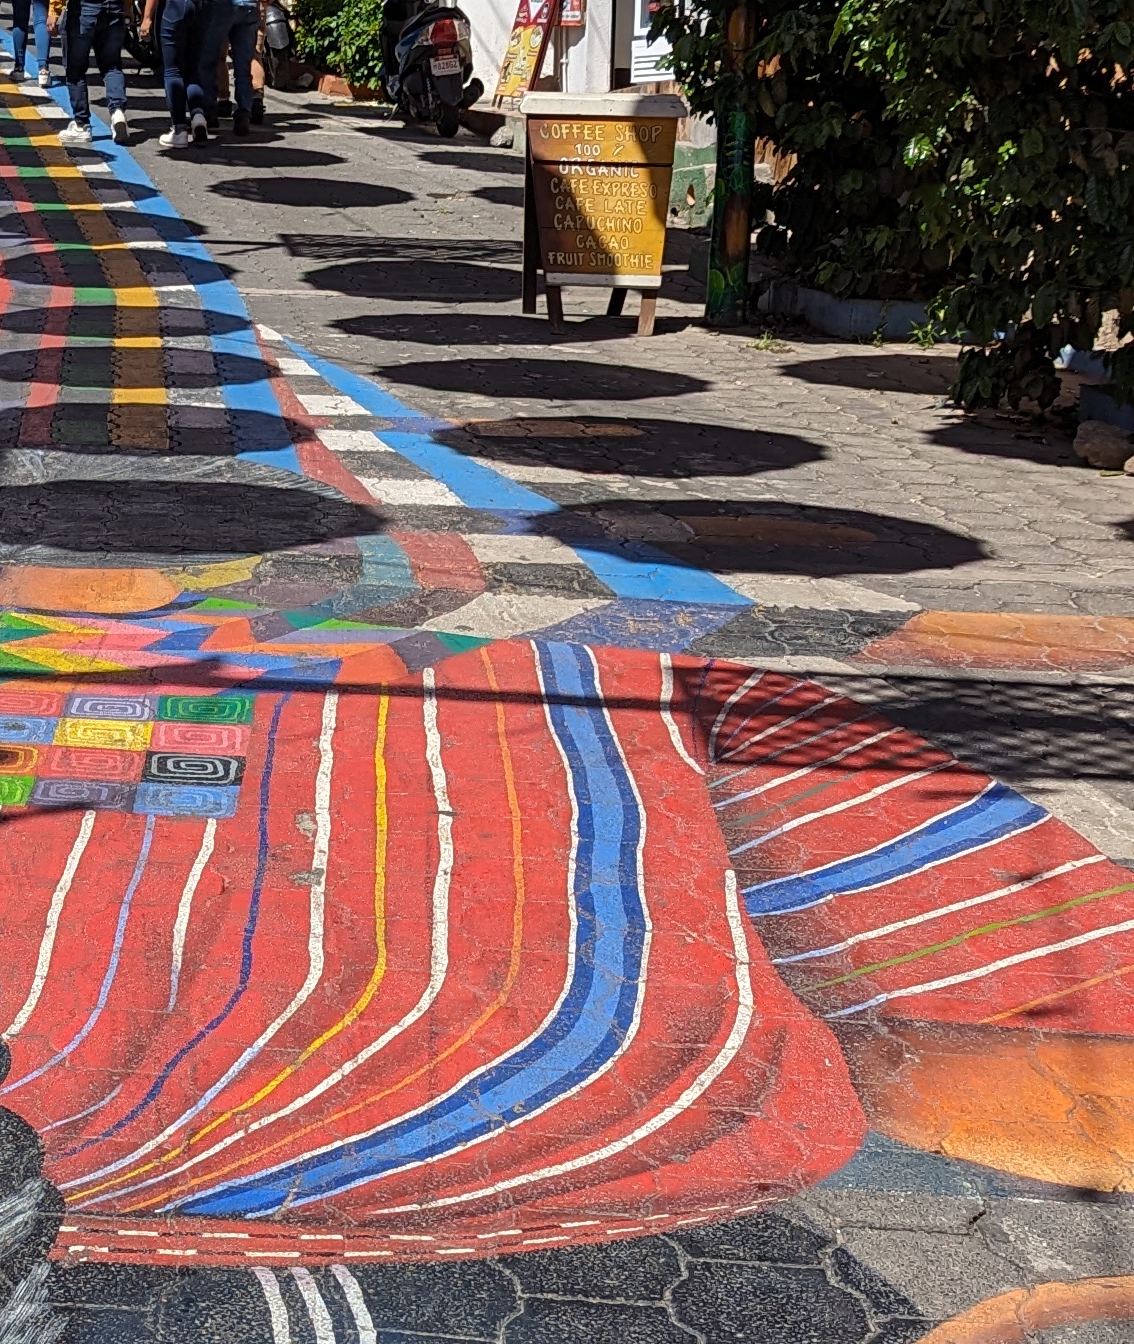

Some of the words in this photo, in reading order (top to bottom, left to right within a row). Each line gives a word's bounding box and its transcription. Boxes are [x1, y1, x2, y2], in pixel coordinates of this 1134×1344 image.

[539, 123, 605, 141] COFFEE
[615, 124, 663, 143] SHOP
[575, 143, 601, 156] 100
[559, 157, 640, 178] ORGANIC
[550, 177, 589, 194] CAFE
[592, 180, 658, 199] EXPRESO
[555, 196, 595, 213] CAFE
[604, 200, 647, 215] LATE
[553, 214, 643, 233] CAPUCHINO
[576, 235, 629, 250] CACAO
[548, 251, 585, 266] FRUIT
[589, 252, 654, 269] SMOOTHIE
